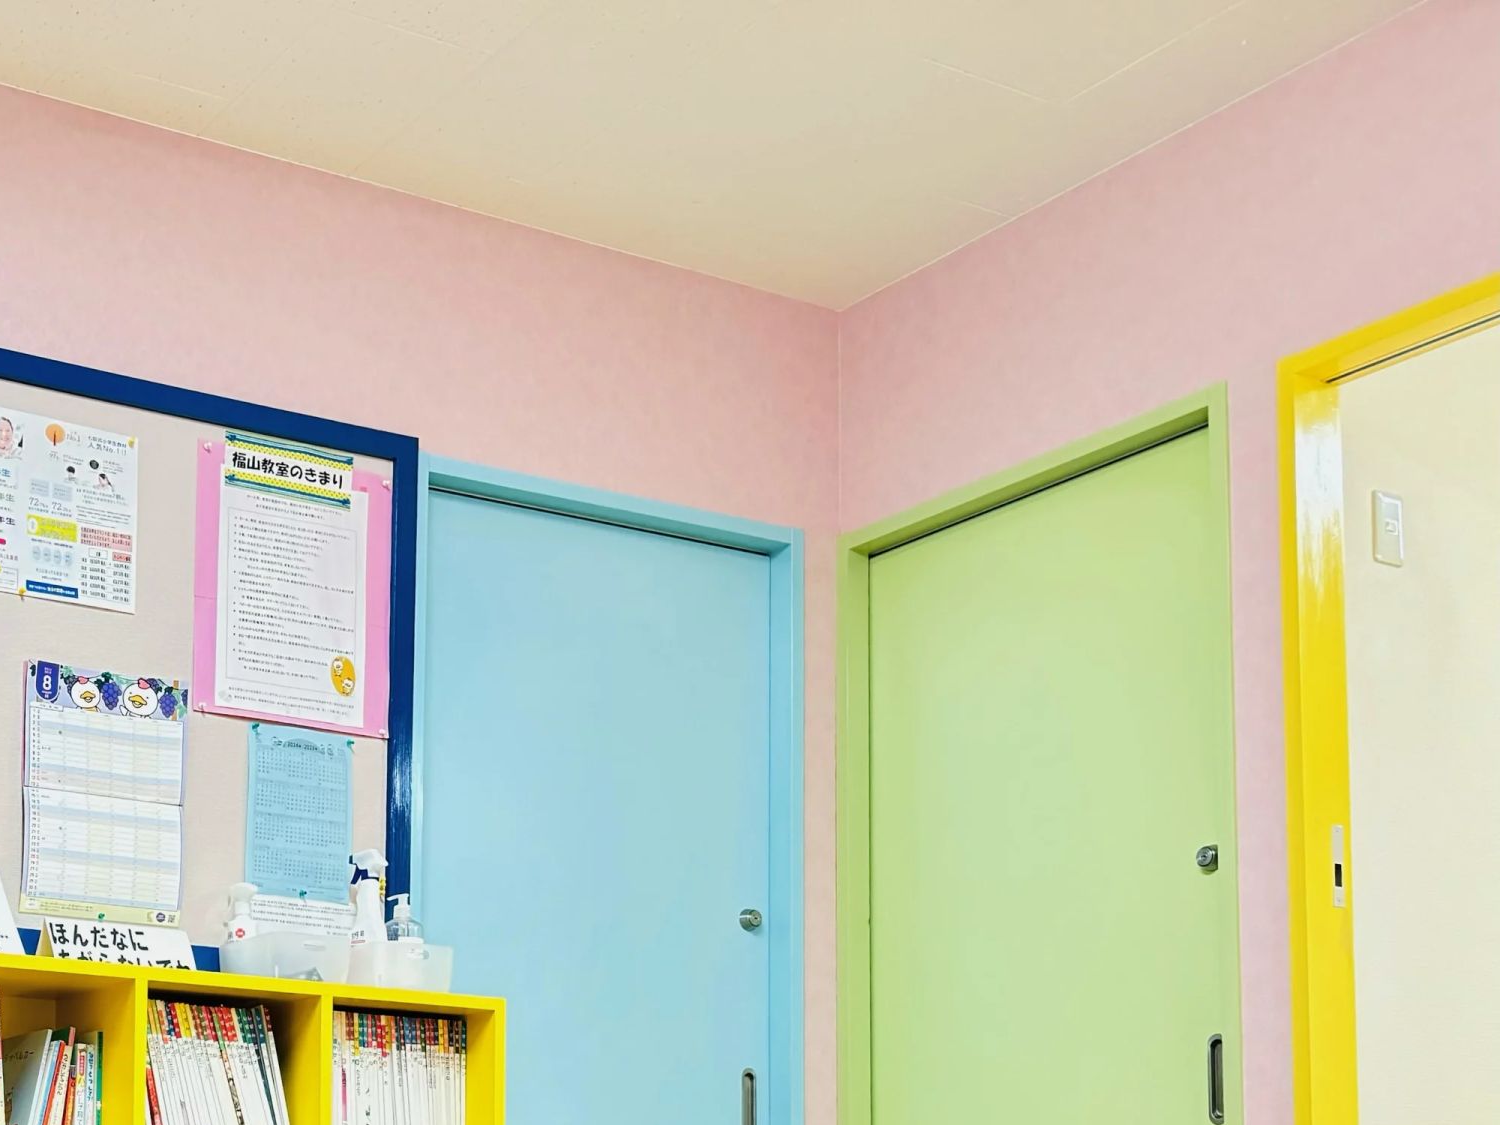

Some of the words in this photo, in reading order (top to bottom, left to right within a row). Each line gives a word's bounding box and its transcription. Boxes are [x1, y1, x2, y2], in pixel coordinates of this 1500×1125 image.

[232, 451, 343, 490] 福山教室のきまり
[42, 674, 51, 690] 8
[49, 922, 149, 951] ほんだなに
